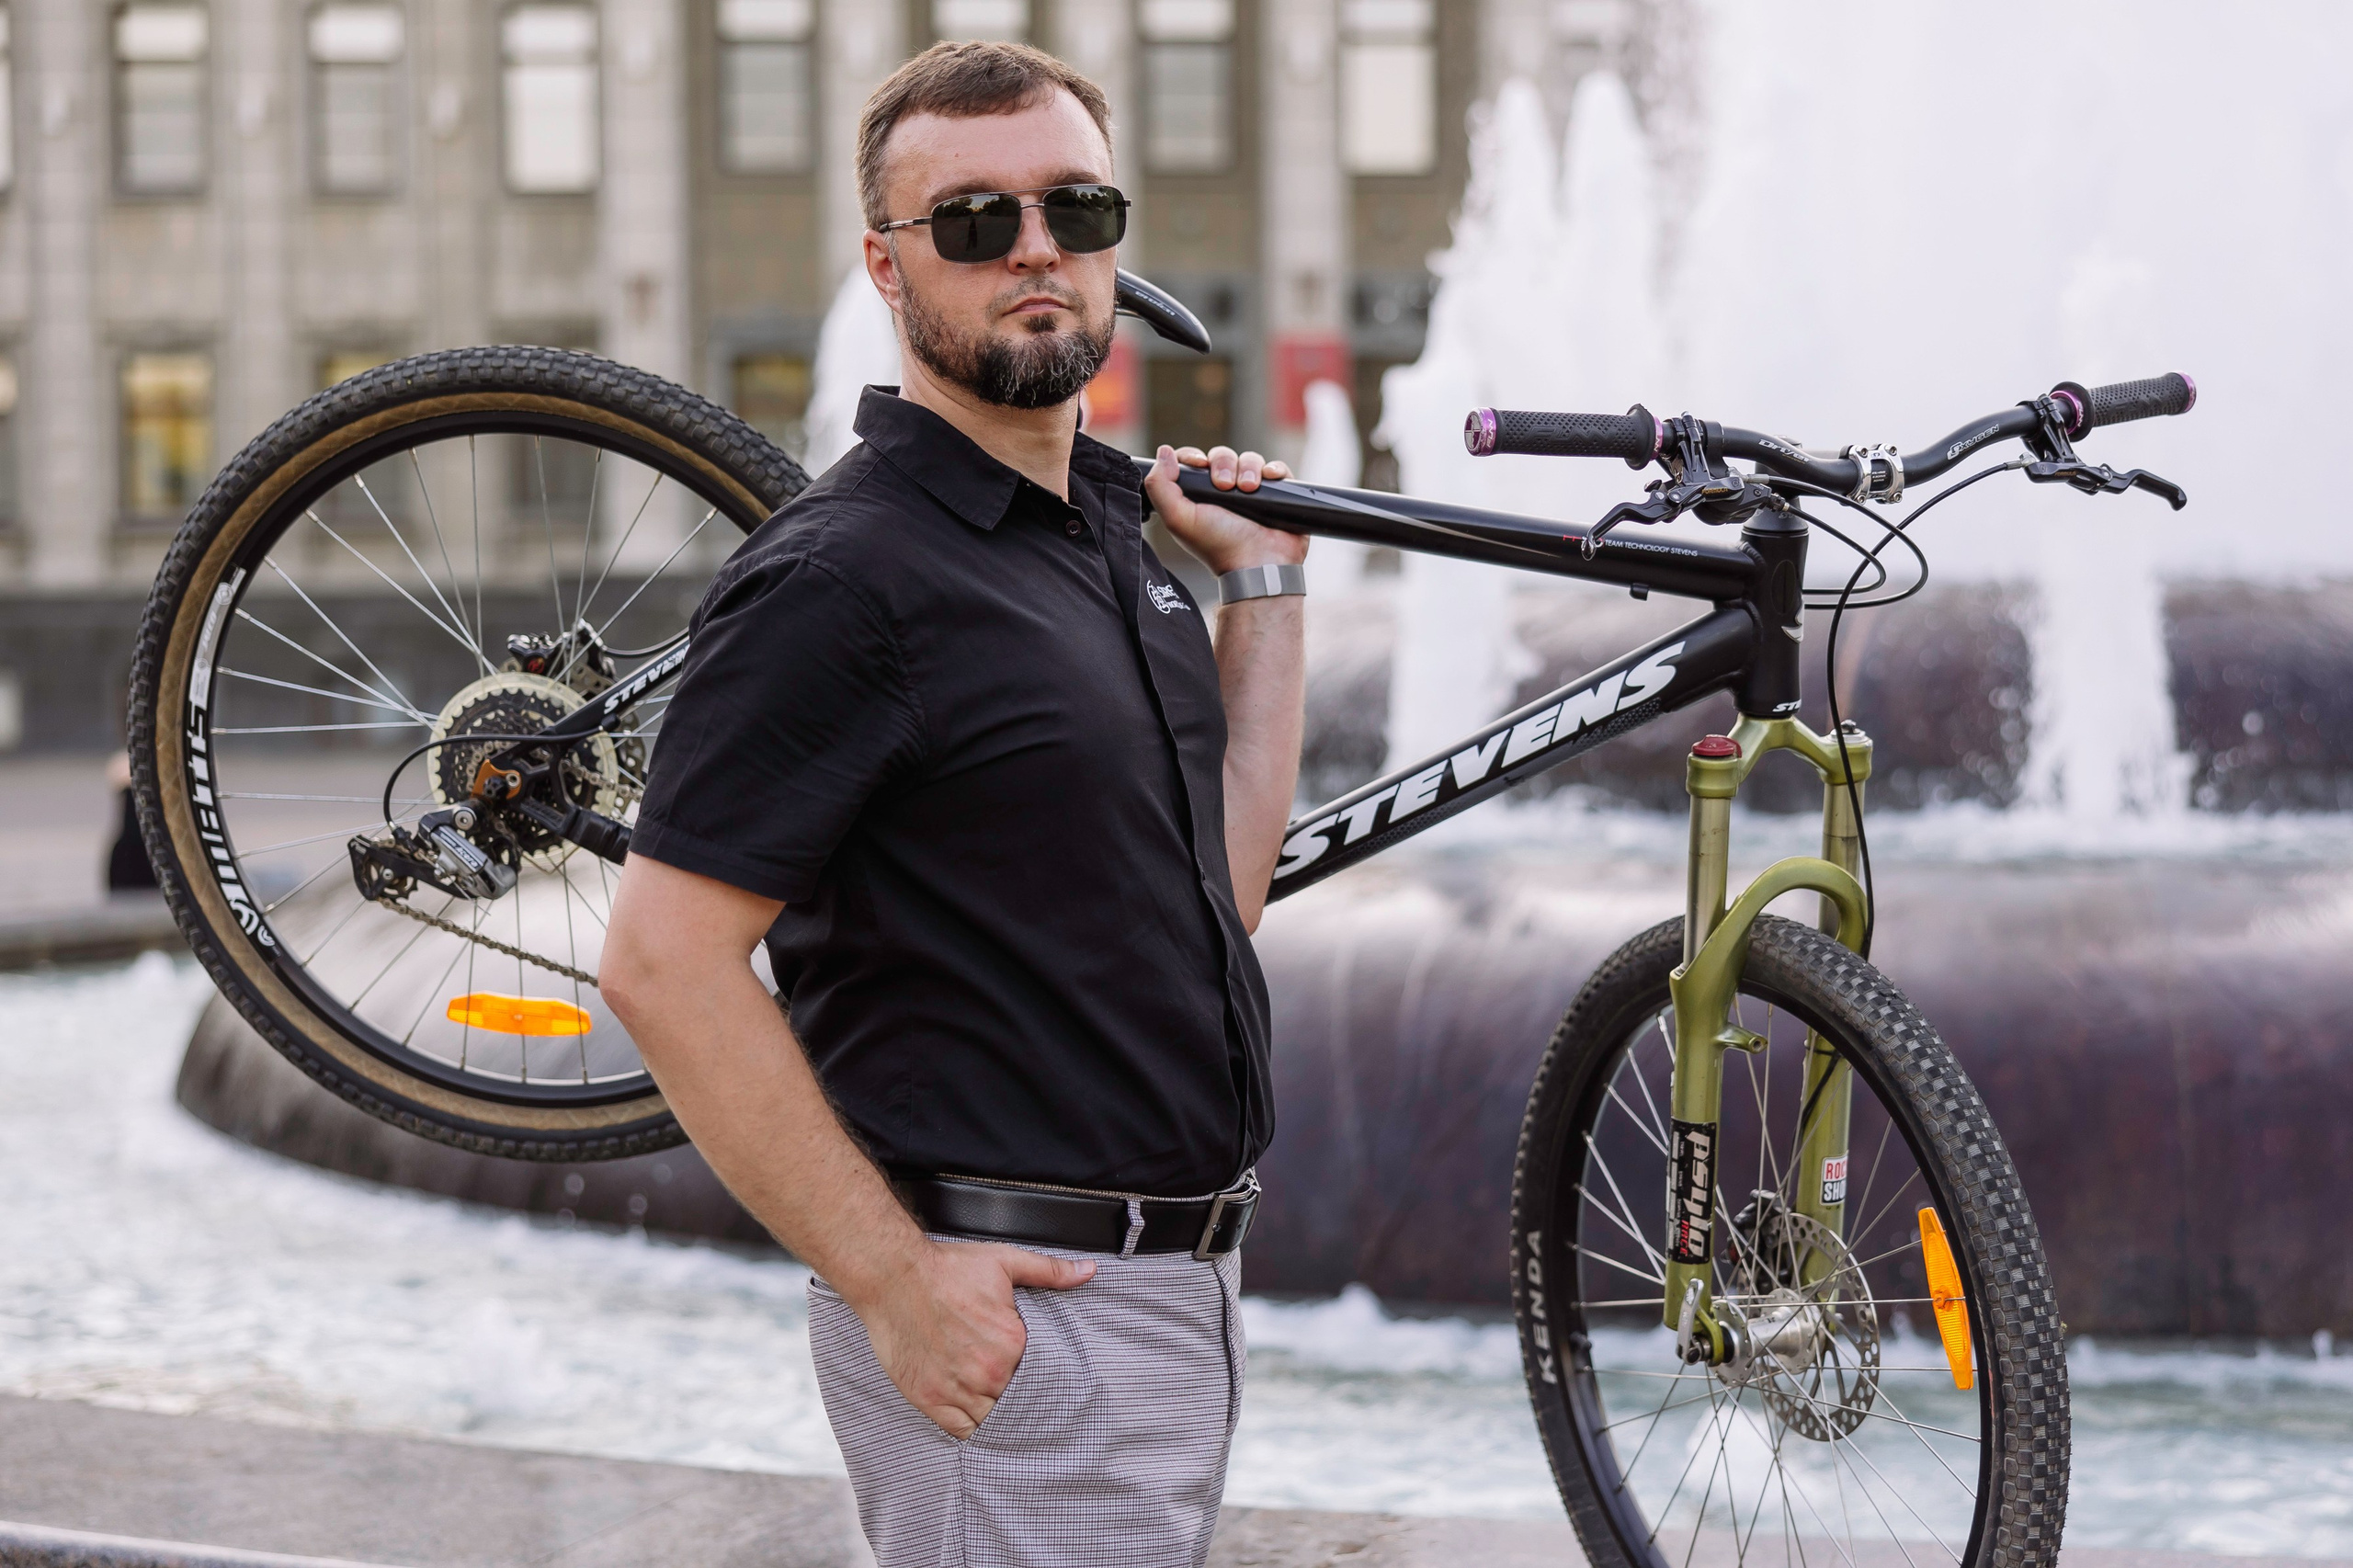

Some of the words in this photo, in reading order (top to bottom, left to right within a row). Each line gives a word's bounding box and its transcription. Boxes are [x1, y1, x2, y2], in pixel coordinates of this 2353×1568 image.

[1605, 539, 1623, 548] TEAM
[1624, 541, 1670, 553] TECHNOLOGY
[1670, 547, 1699, 557] STEVENS
[1272, 641, 1687, 881] STEVENS
[1526, 1230, 1558, 1385] KENDA
